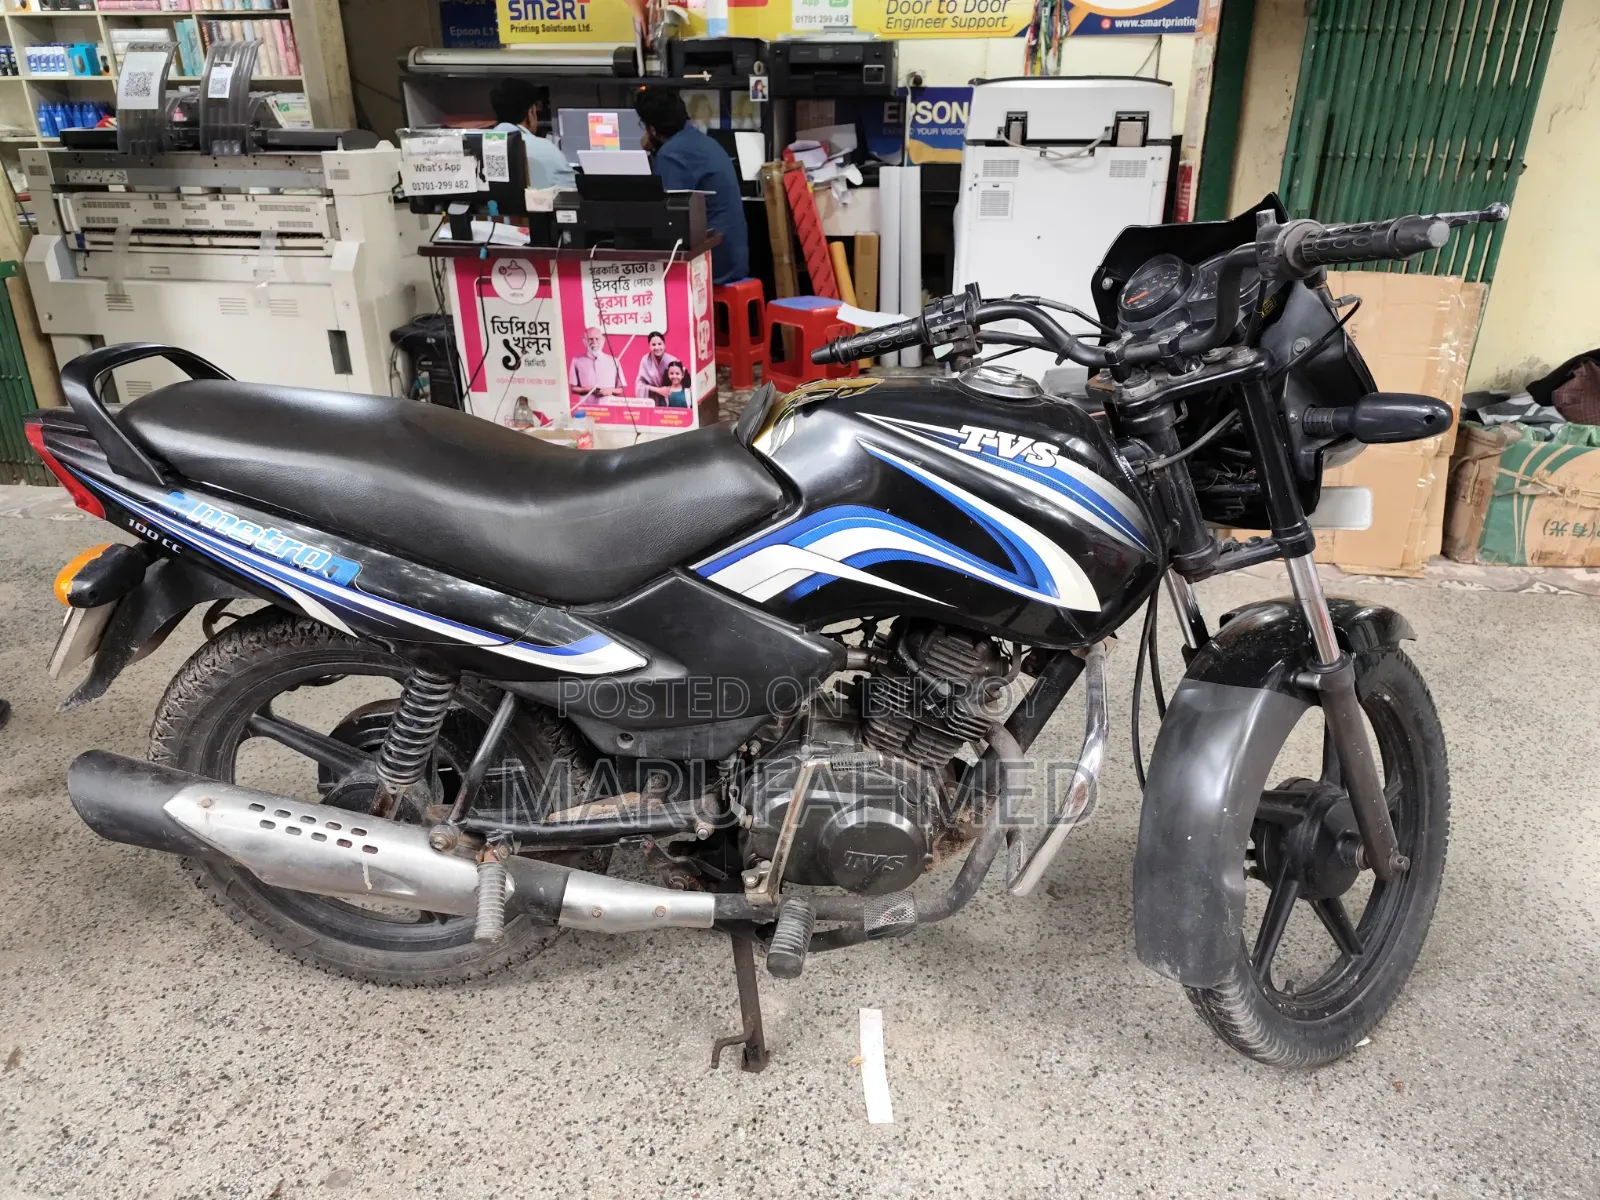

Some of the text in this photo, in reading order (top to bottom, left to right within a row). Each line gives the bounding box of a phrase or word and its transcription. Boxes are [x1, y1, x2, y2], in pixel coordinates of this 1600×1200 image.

[886, 0, 1010, 14] Door to Door
[795, 15, 817, 24] 01701
[886, 15, 1008, 31] Engineer Support
[450, 26, 481, 38] Epson
[510, 23, 593, 34] Printing Solutions Ltd.
[883, 101, 969, 124] EPSON
[414, 162, 462, 173] What's App
[412, 180, 469, 191] 01701-299 482
[621, 262, 648, 275] ভাতা
[592, 276, 630, 293] উপবৃত্তি
[631, 290, 653, 307] পাই
[490, 315, 550, 336] ডিপিএস
[512, 336, 552, 356] খুলুন
[958, 424, 1060, 468] TVS
[128, 518, 161, 541] 100
[187, 502, 333, 571] metro
[843, 850, 908, 876] TVS
